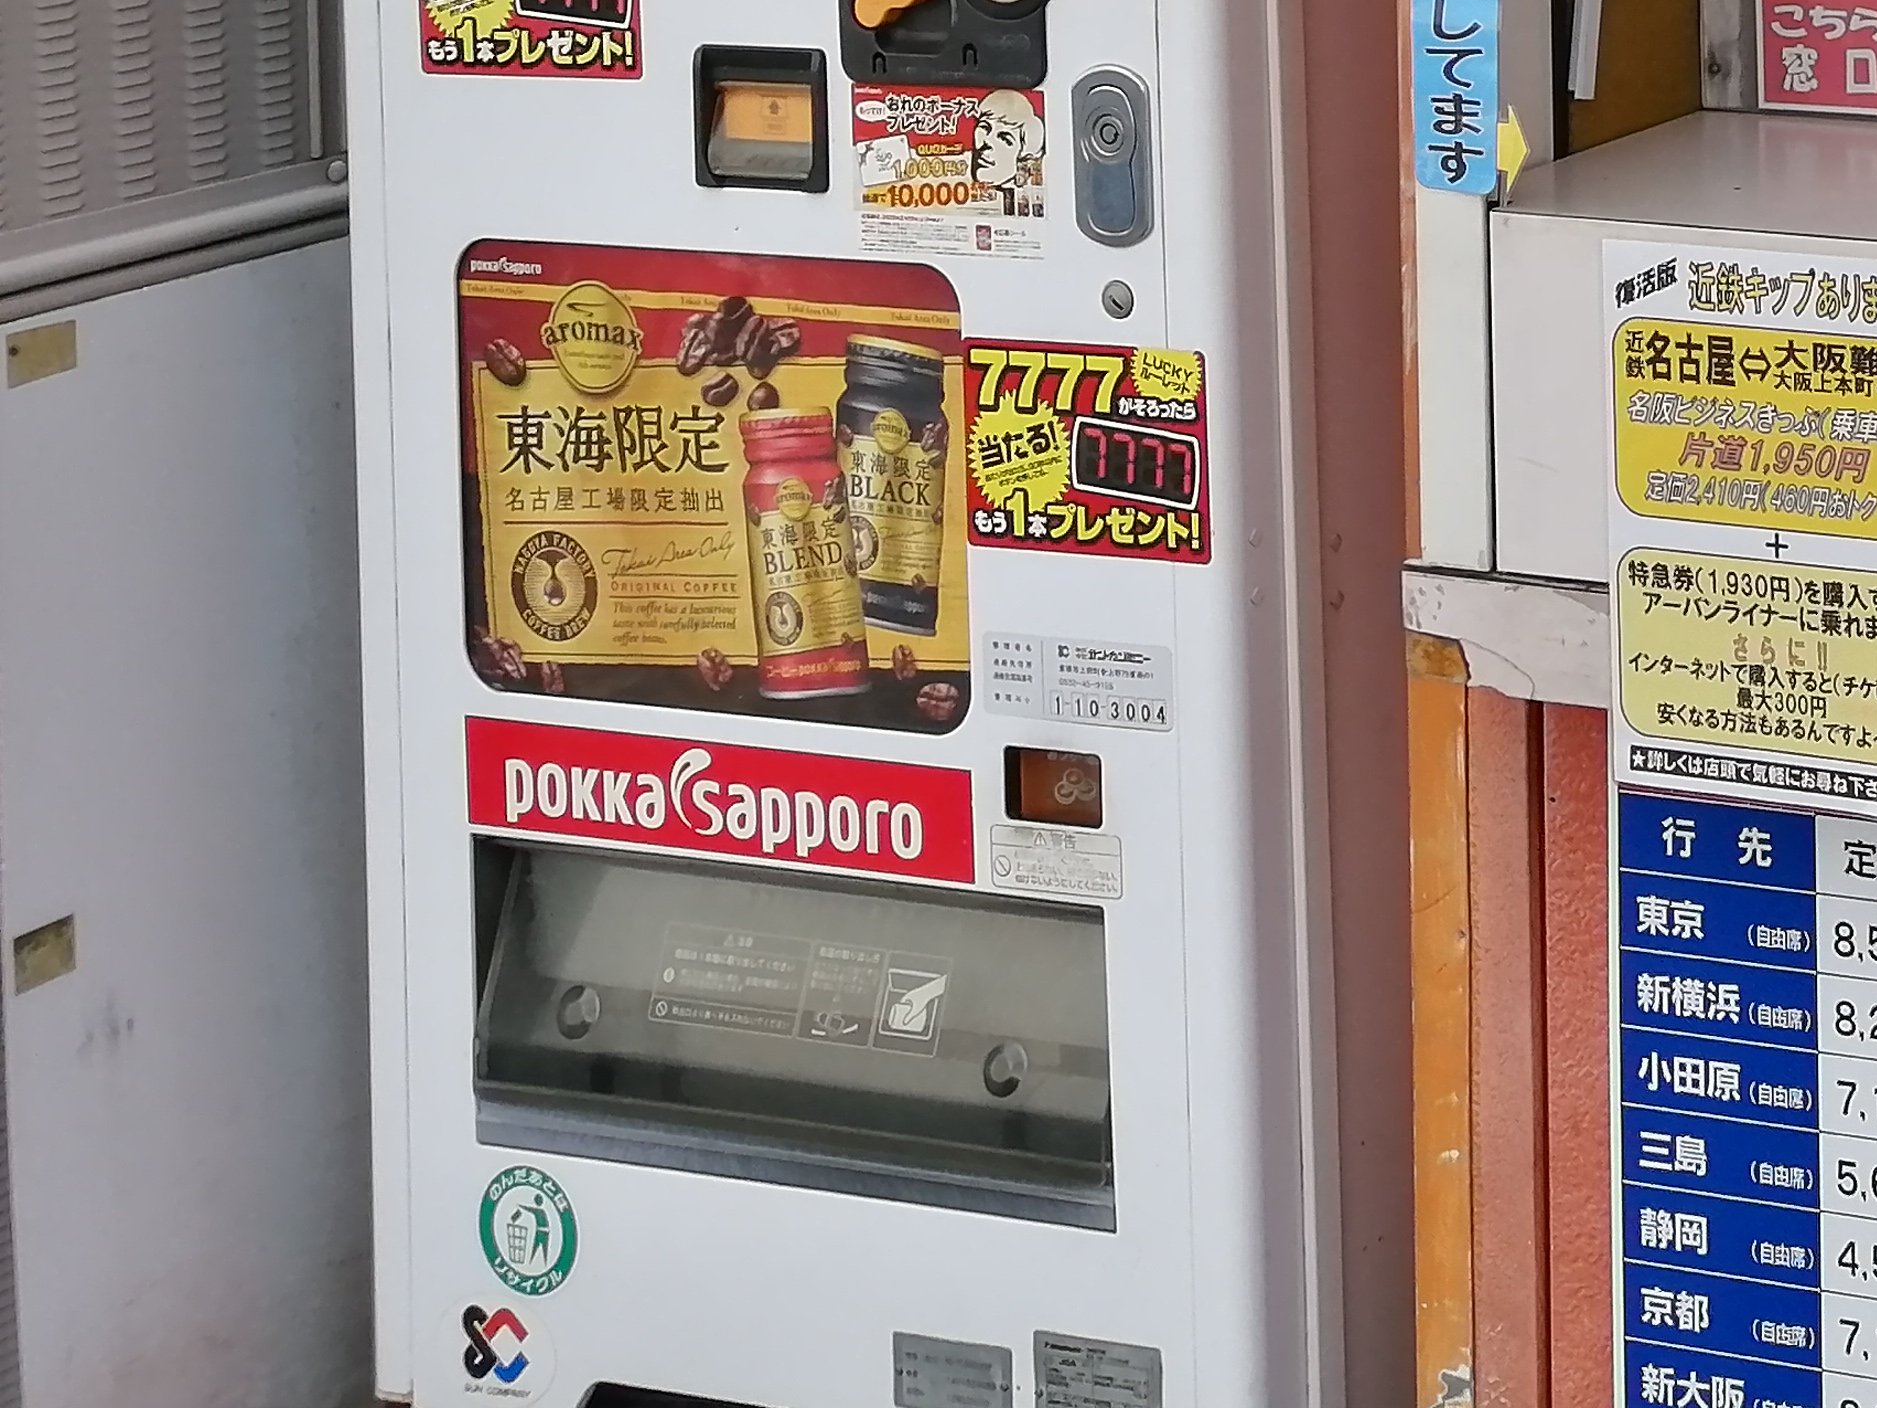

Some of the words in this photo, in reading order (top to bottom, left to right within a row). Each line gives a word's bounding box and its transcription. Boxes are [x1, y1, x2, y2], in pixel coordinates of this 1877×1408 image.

[428, 17, 634, 67] もう1本プレゼント!
[887, 94, 979, 116] おれのボーナス
[1614, 258, 1679, 309] 復活版
[545, 320, 641, 351] aromax
[970, 348, 1125, 415] 7777
[1142, 351, 1193, 381] LUCKY
[1646, 331, 1737, 388] 名古屋
[496, 405, 731, 474] 東海限定
[978, 420, 1059, 469] 当たる!
[1678, 431, 1873, 483] 片道1,950円
[505, 485, 725, 513] 名古屋工場限定抽出
[850, 474, 931, 506] BLACK
[975, 487, 1202, 551] もう1本プレゼント!
[762, 540, 842, 575] BLEND
[685, 582, 736, 593] COFFEE
[1054, 694, 1167, 724] 1-10-3004
[1735, 688, 1829, 719] 最大300円
[1637, 894, 1705, 941] 東京
[1637, 973, 1742, 1025] 新横浜
[1638, 1050, 1742, 1103] 小田原
[1638, 1129, 1708, 1177] 三島
[488, 1167, 567, 1212] のんだあとは
[1639, 1207, 1709, 1256] 静岡
[1640, 1286, 1710, 1333] 京都
